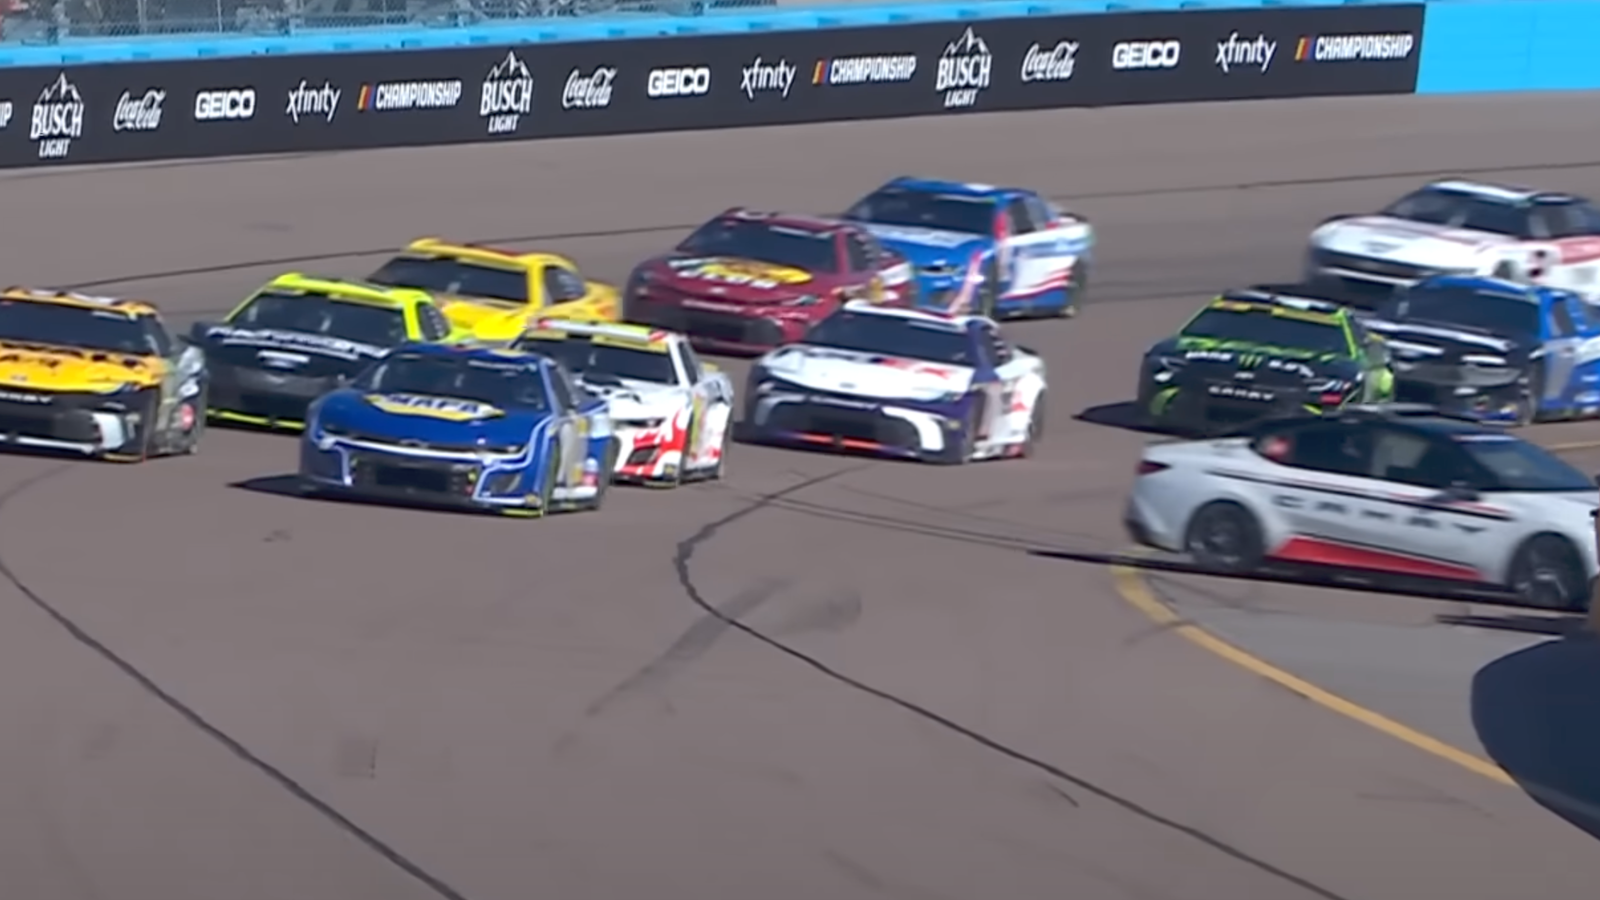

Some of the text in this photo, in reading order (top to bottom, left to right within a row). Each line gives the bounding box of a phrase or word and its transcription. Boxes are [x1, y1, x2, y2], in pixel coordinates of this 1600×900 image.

[1111, 40, 1181, 69] GEICO
[1215, 32, 1277, 73] xfinity
[1314, 34, 1414, 61] CHAMPIONSHIP
[647, 67, 711, 97] GEICO
[740, 57, 797, 99] xfinity
[829, 55, 917, 84] CHAMPIONSHIP
[936, 54, 992, 91] BUSCH
[194, 89, 256, 120] GEICO
[286, 80, 341, 123] xfinity
[375, 80, 462, 110] CHAMPIONSHIP
[480, 78, 533, 116] BUSCH
[944, 88, 979, 107] LIGHT
[30, 103, 84, 140] BUSCH
[488, 114, 519, 133] LIGHT
[39, 138, 71, 158] LIGHT
